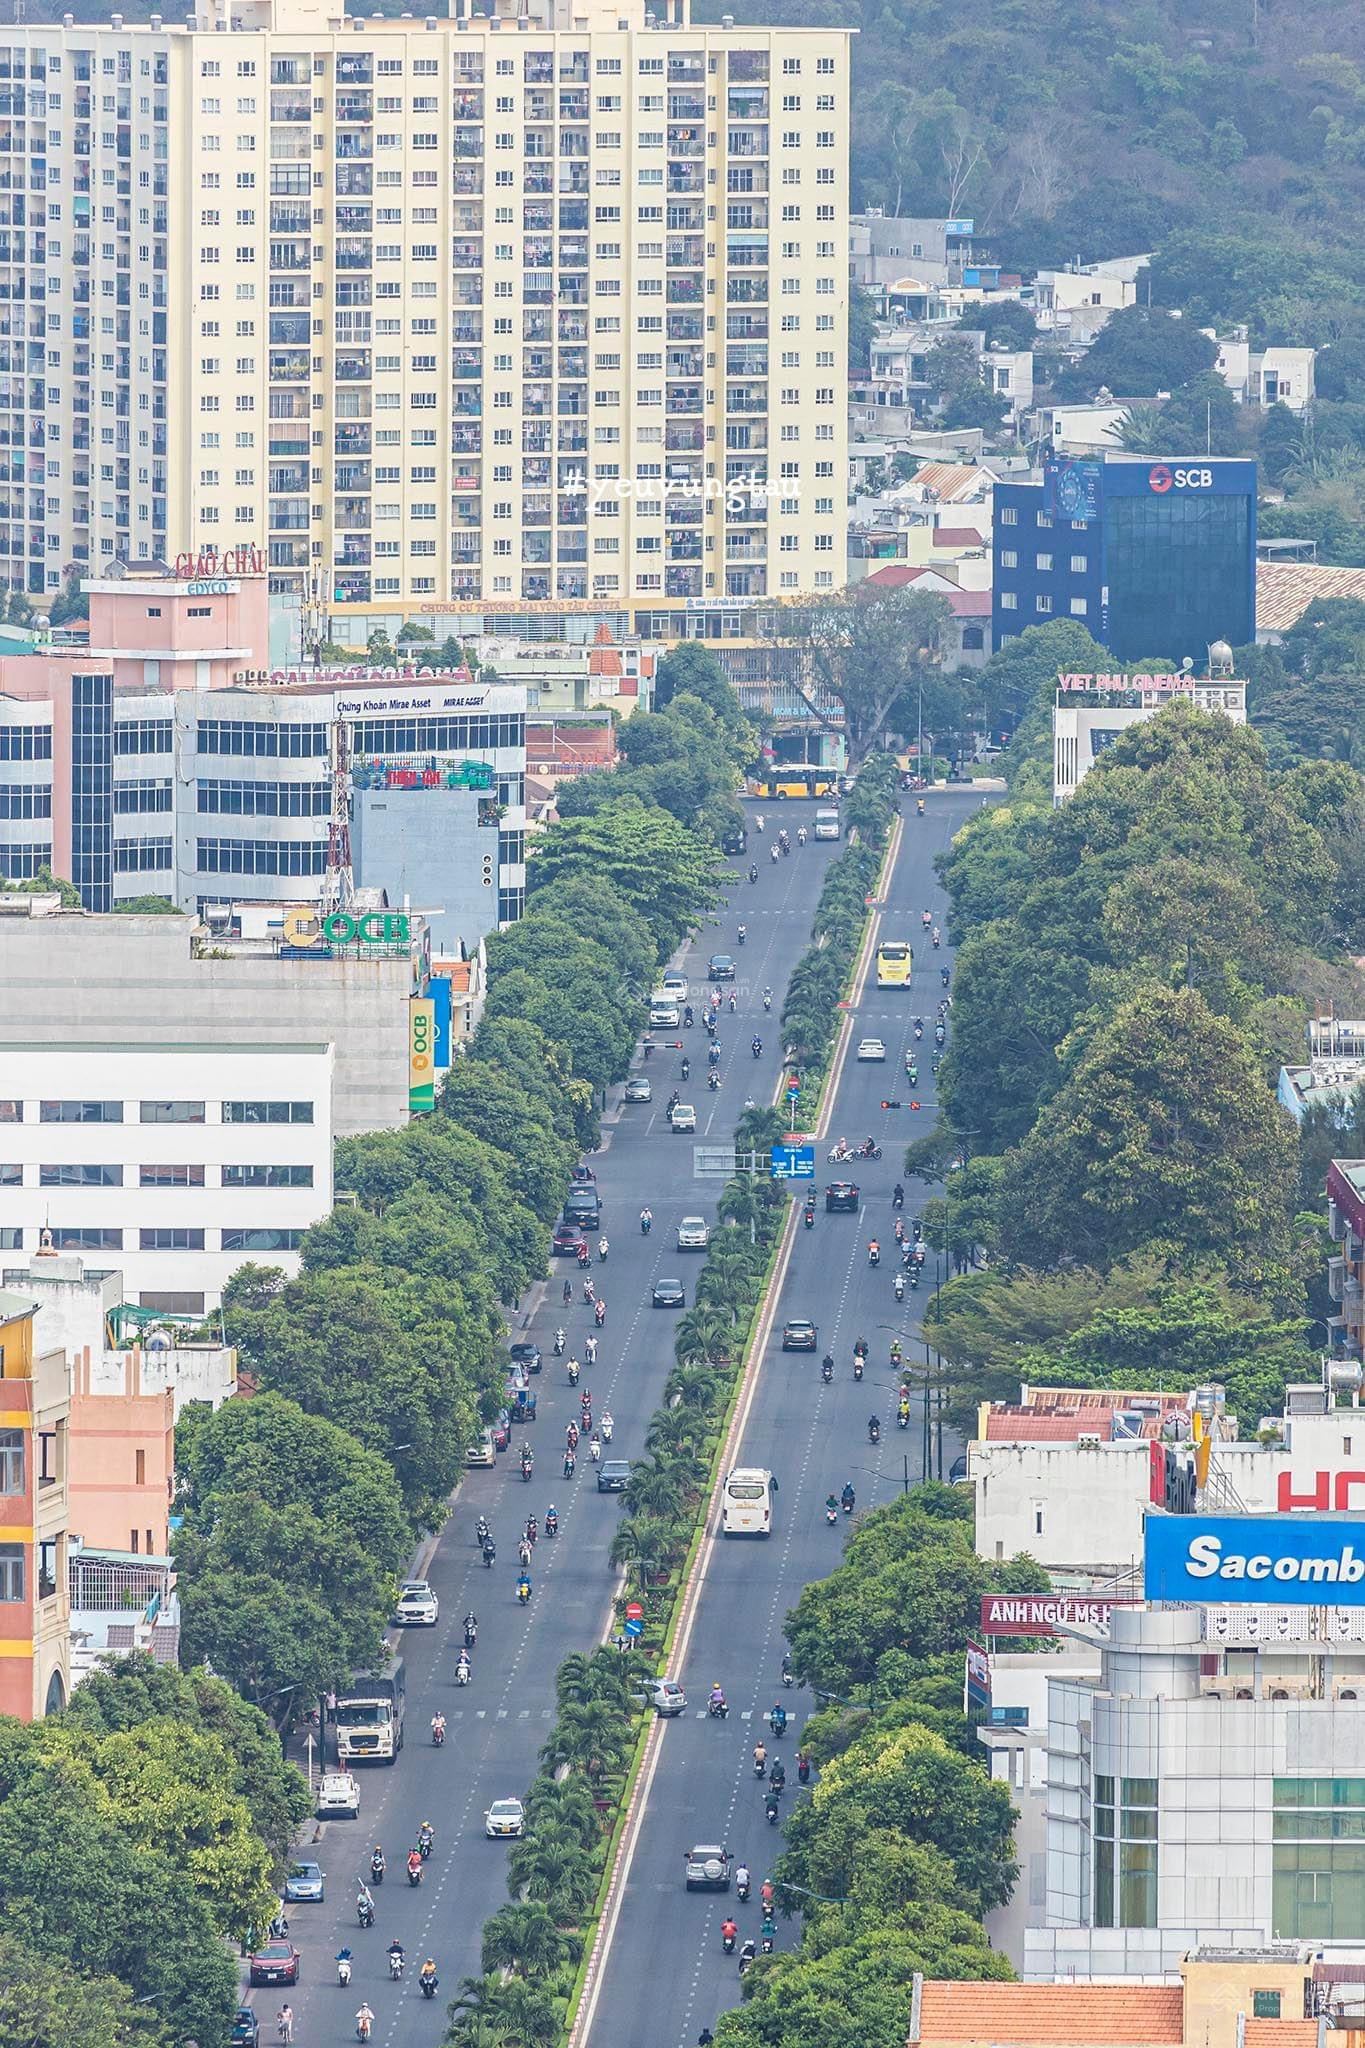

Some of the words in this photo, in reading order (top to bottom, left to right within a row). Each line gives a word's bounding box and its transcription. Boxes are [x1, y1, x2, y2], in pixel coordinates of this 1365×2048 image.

[1174, 469, 1213, 488] SCB
[187, 582, 228, 596] EDYCO
[337, 701, 361, 714] Chứng
[363, 699, 388, 711] Khoán
[389, 699, 409, 709] Mirae
[410, 699, 431, 709] Asset
[443, 698, 464, 707] MIRAE
[324, 913, 409, 943] OCB
[414, 1015, 427, 1053] OCB
[989, 1601, 1028, 1622] ANH
[1031, 1597, 1071, 1623] NGỮ
[1074, 1603, 1100, 1624] MS
